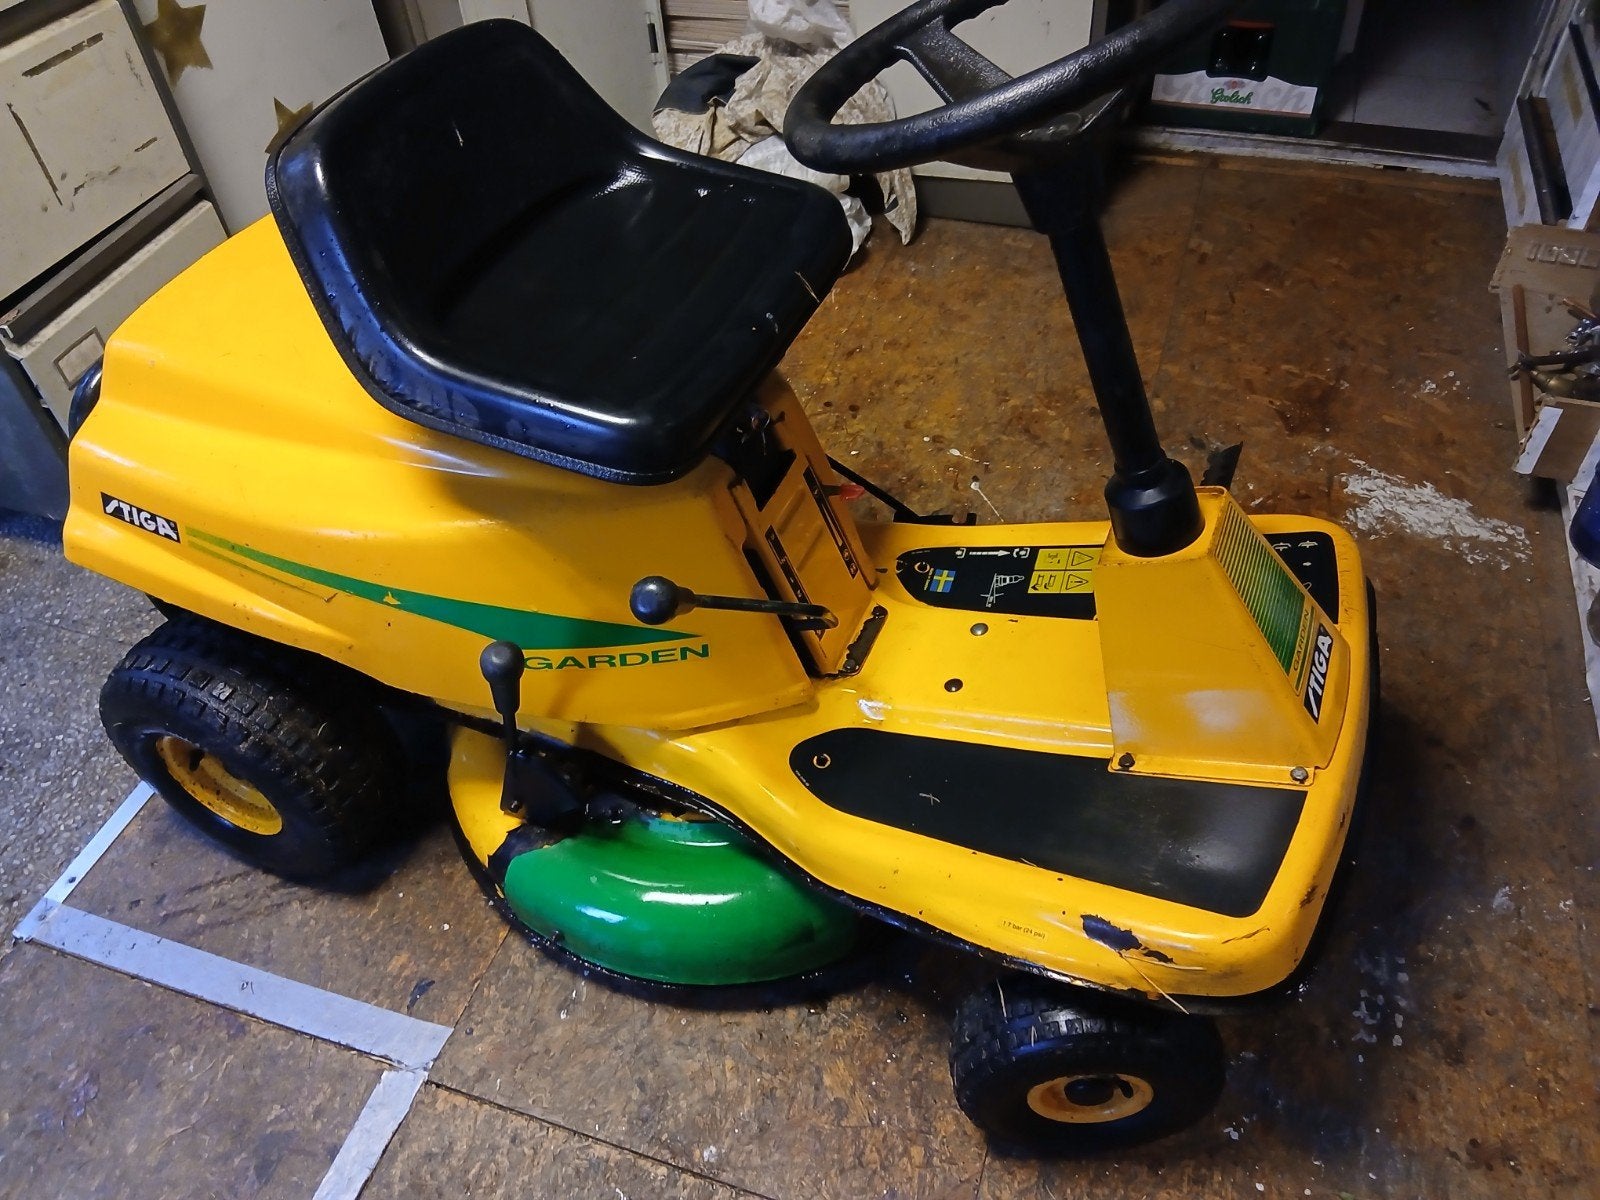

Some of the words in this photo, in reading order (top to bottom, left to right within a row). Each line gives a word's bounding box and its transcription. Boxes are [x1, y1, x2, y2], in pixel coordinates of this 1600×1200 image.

[1210, 87, 1254, 105] Grolsch
[105, 499, 178, 541] STIGA
[524, 643, 710, 670] GARDEN
[1293, 609, 1310, 672] GARDEN
[1306, 634, 1333, 718] STIGA
[1012, 923, 1023, 931] bar
